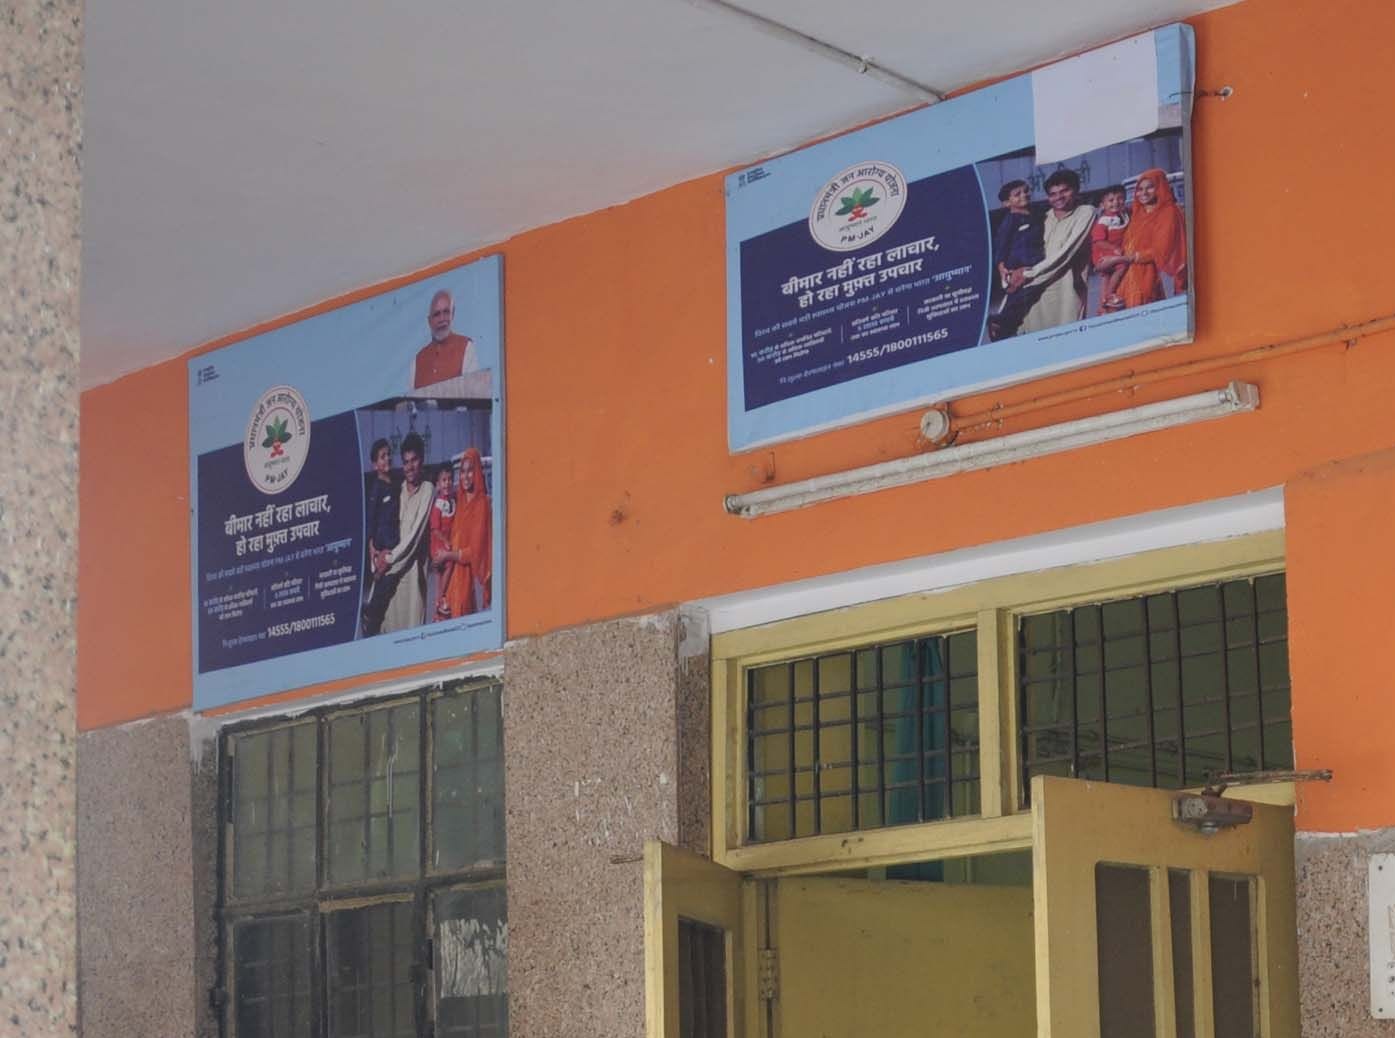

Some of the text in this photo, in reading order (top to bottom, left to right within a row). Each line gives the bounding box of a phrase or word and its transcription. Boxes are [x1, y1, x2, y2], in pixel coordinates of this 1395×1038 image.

[781, 236, 940, 296] बीमार नहीं रहा लाचार,
[798, 292, 815, 308] हो
[817, 284, 839, 303] रहा
[879, 258, 924, 282] उपचार
[847, 327, 949, 365] 14555/1800111565
[224, 515, 253, 536] बीमार
[255, 504, 276, 526] नहीं
[276, 504, 293, 522] रहा
[235, 536, 246, 556] हो
[249, 535, 264, 552] रहा
[290, 520, 320, 541] उपचार
